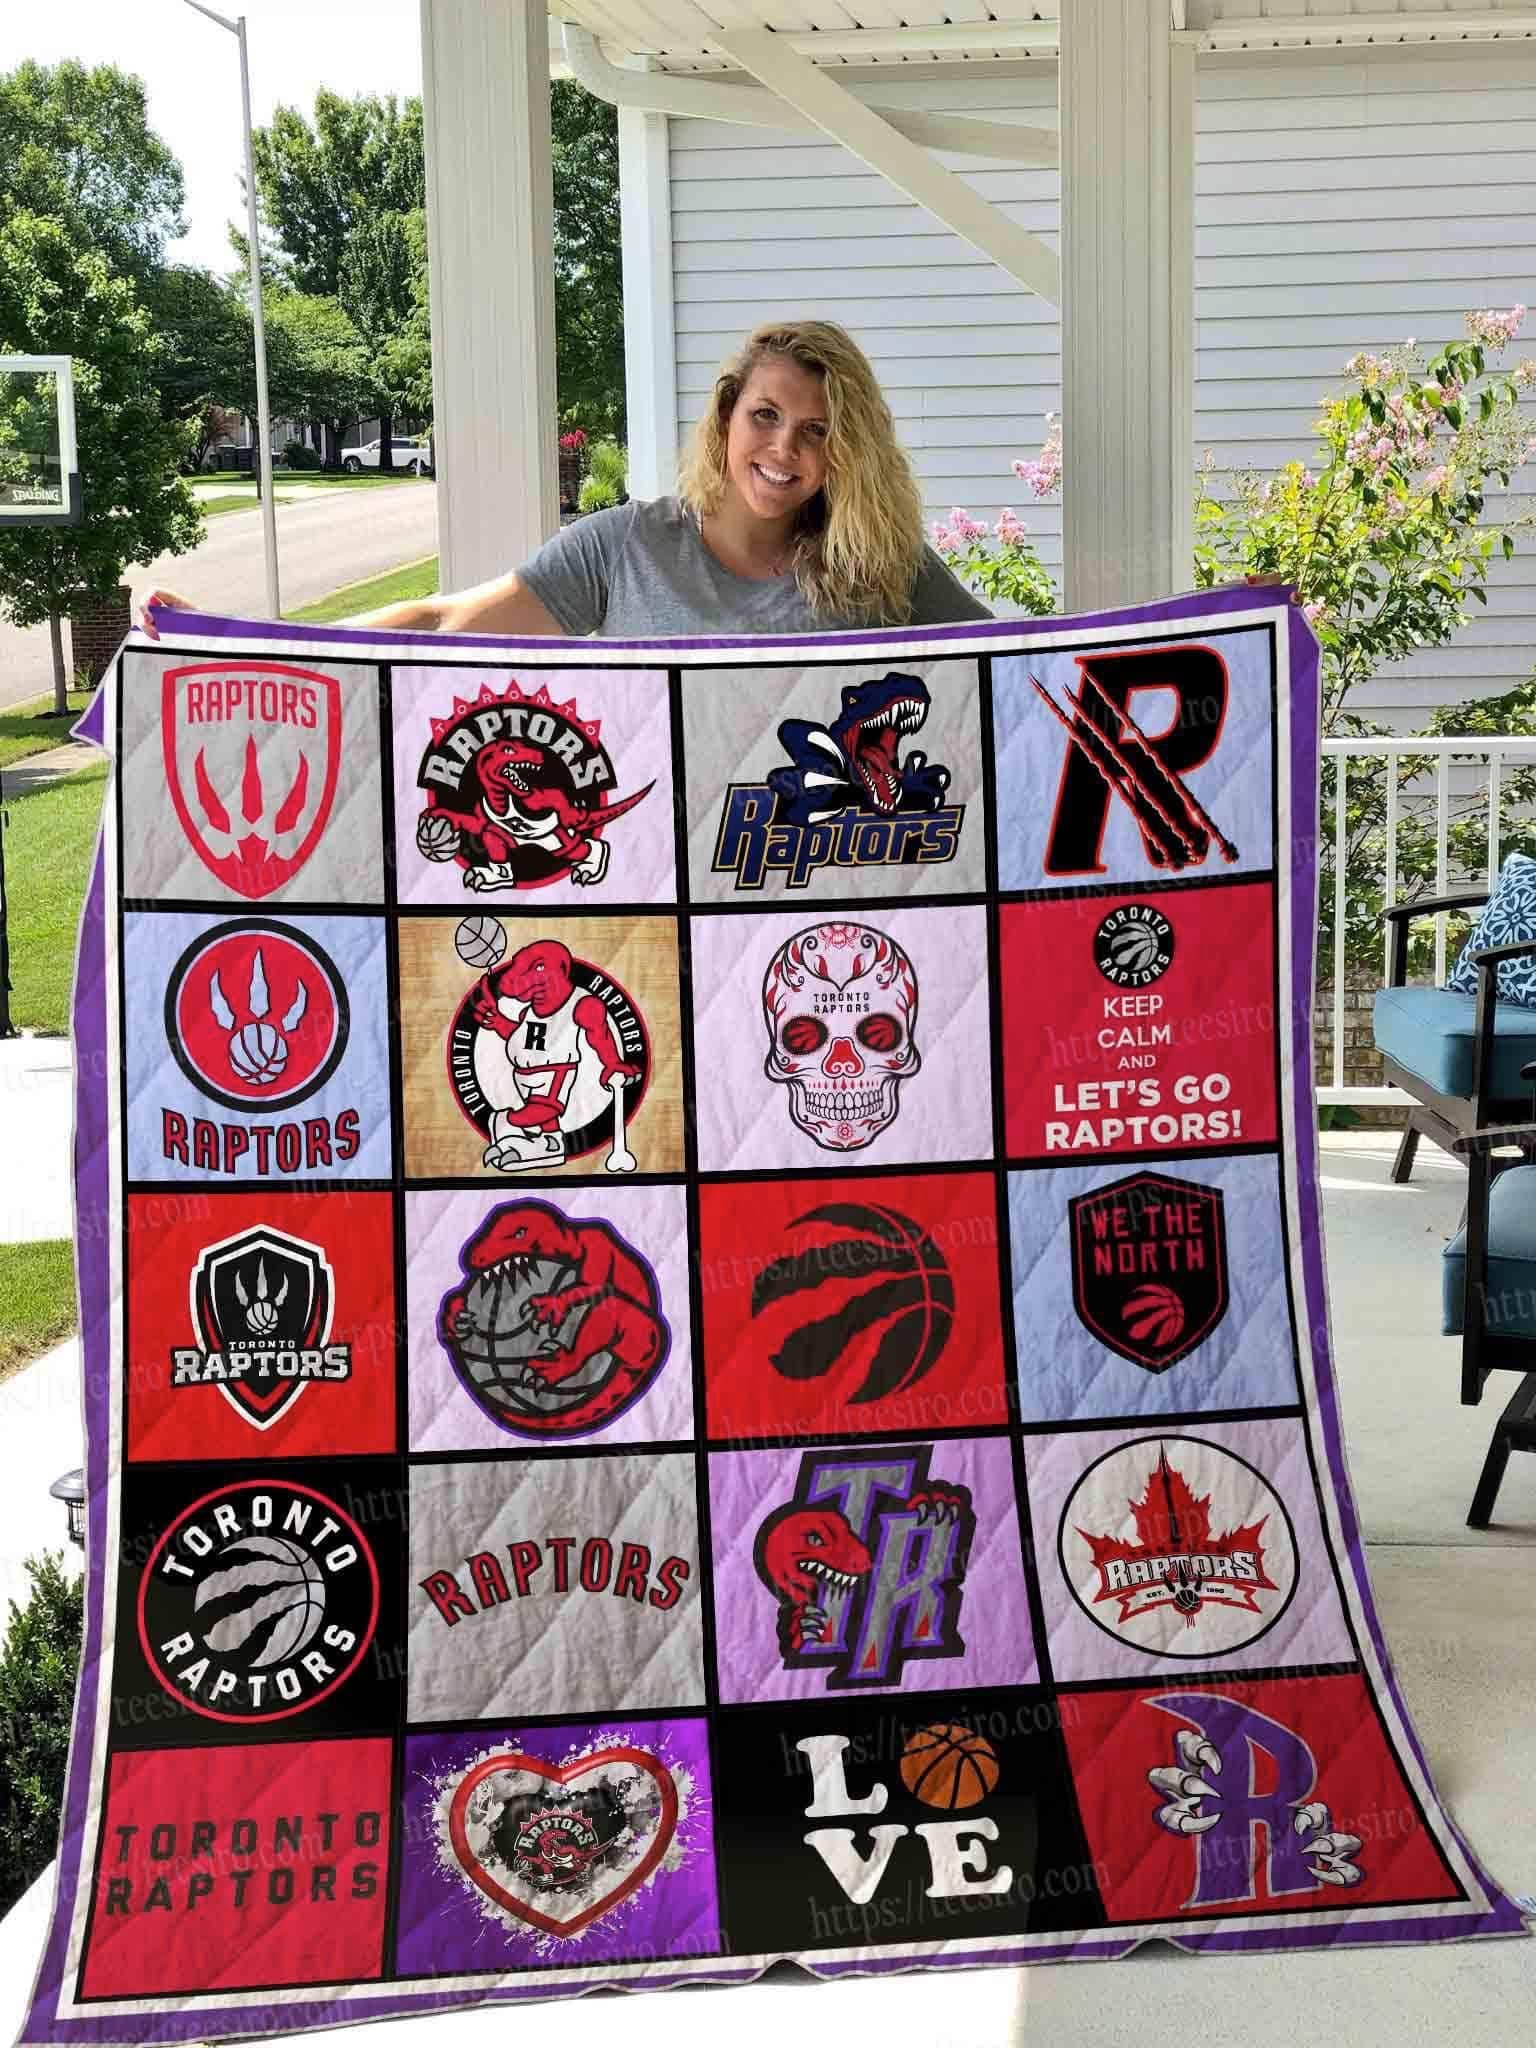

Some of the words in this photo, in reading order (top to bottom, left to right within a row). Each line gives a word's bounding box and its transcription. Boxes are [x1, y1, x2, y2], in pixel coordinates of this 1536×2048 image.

[187, 679, 318, 730] RAPTORS
[435, 689, 597, 735] TORONTO
[423, 707, 610, 792] RAPTORS
[1099, 906, 1169, 938] TORONTO
[1100, 953, 1170, 986] RAPTORS
[589, 975, 643, 1055] RAPTORS
[813, 992, 870, 1003] TORONTO
[813, 1003, 870, 1014] RAPTORS
[1103, 994, 1164, 1019] KEEP
[523, 1020, 546, 1051] R
[1097, 1024, 1171, 1049] CALM
[451, 1029, 480, 1116] TORONTO
[1117, 1054, 1156, 1070] AND
[1054, 1078, 1161, 1113] LET'S
[1173, 1073, 1231, 1104] GO
[161, 1107, 361, 1176] RAPTORS
[1044, 1110, 1242, 1151] RAPTORS!
[1091, 1206, 1129, 1240] WE
[1143, 1202, 1203, 1237] THE
[1094, 1238, 1206, 1276] NORTH
[228, 1339, 295, 1350] TORONTO
[173, 1347, 350, 1384] RAPTORS
[162, 1495, 358, 1580] TORONTO
[419, 1537, 690, 1627] RAPTORS
[1104, 1551, 1260, 1592] RAPTORS
[160, 1624, 357, 1707] RAPTORS
[115, 1811, 381, 1863] TORONTO
[518, 1817, 595, 1849] RAPTORS
[105, 1863, 378, 1916] RAPTORS
